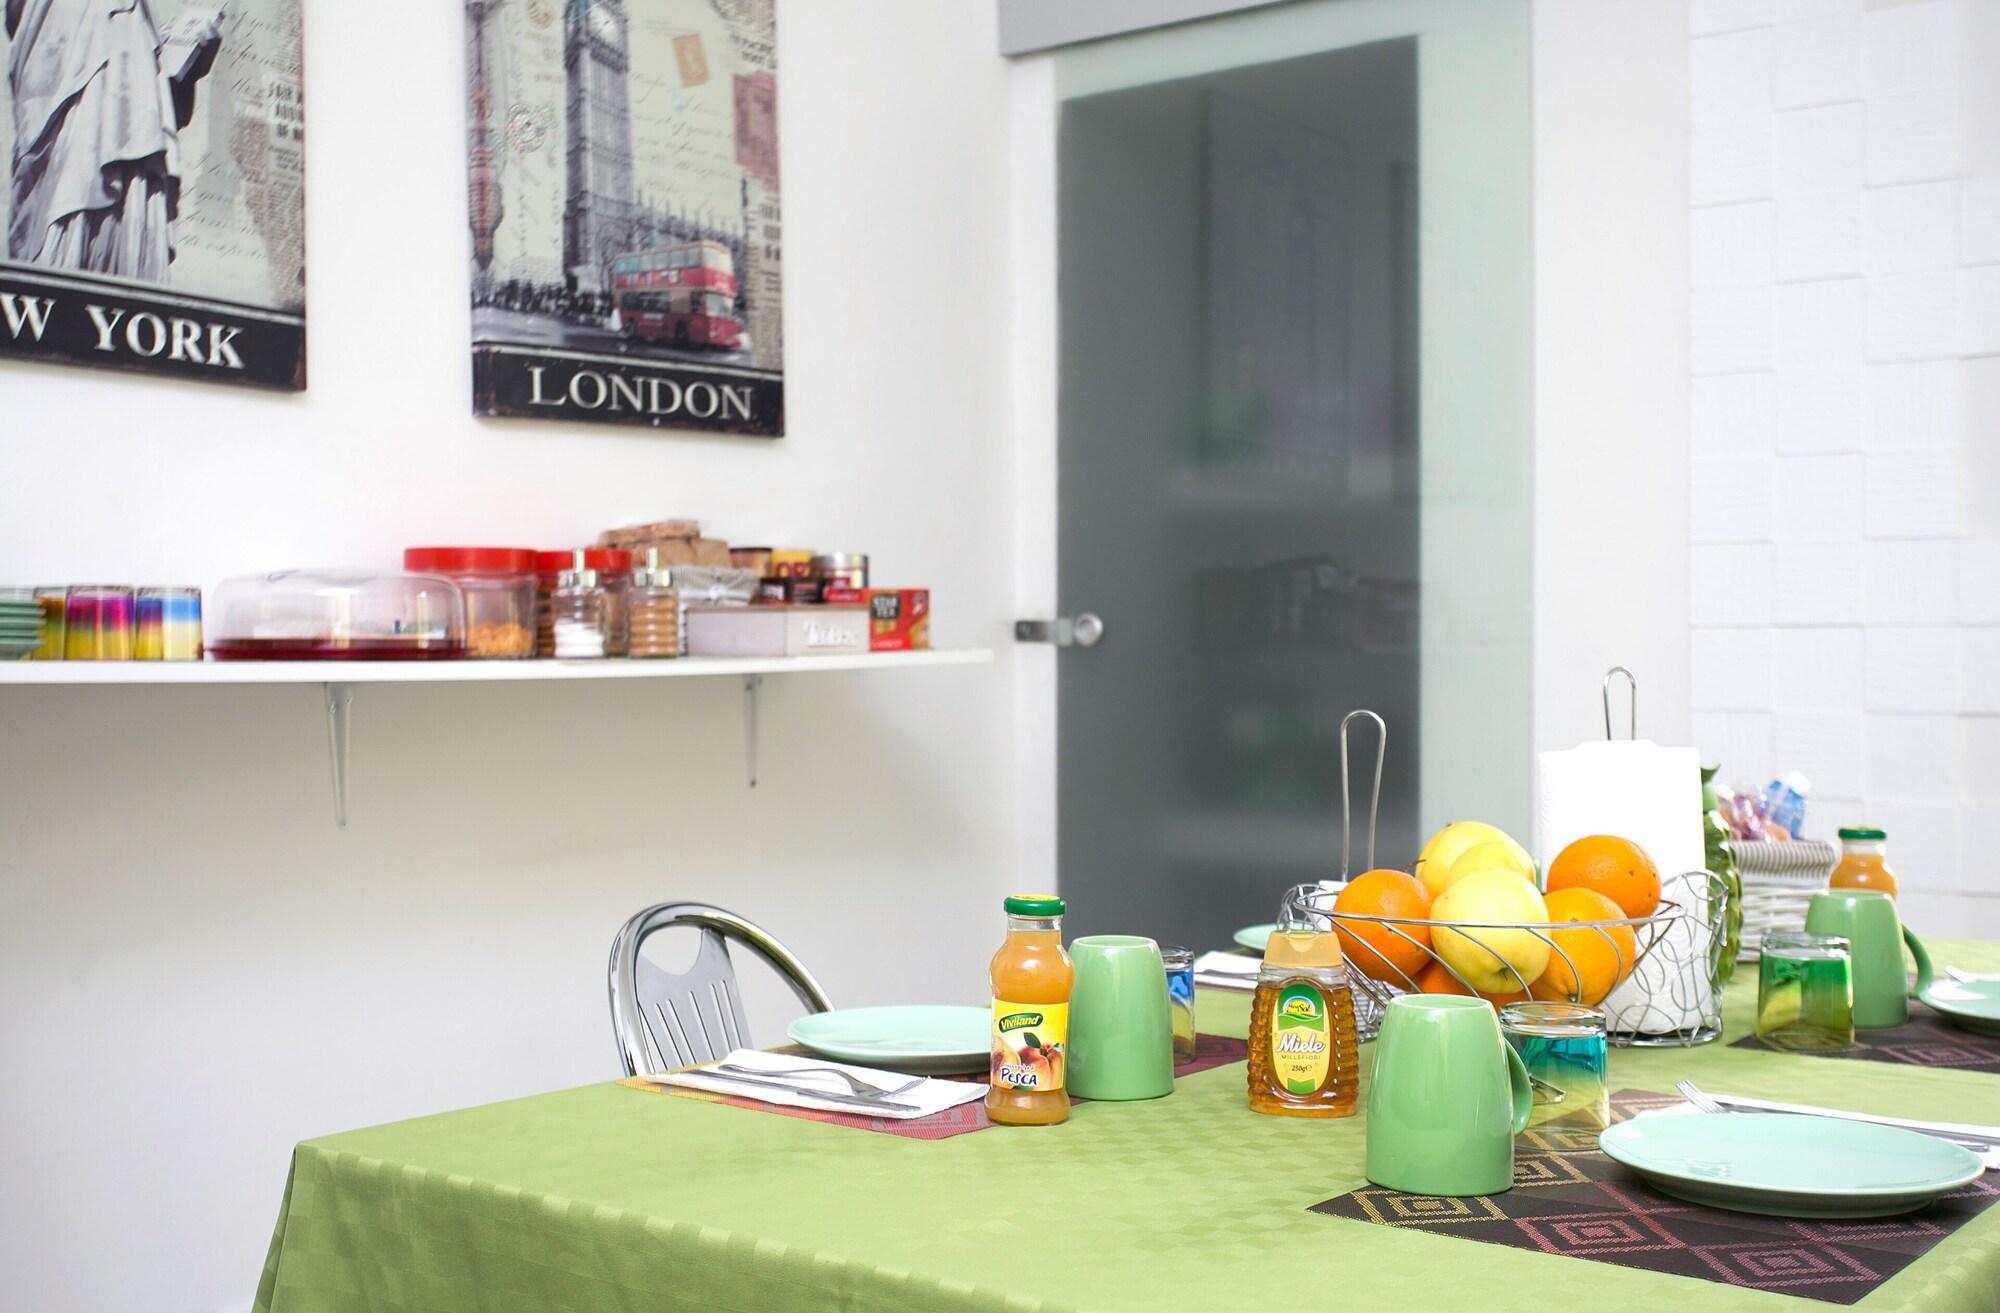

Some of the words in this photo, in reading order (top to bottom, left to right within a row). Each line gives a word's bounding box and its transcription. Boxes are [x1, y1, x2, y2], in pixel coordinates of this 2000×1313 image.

[85, 304, 246, 370] YORK
[528, 366, 754, 421] LONDON
[1000, 1015, 1040, 1030] Viviland
[1276, 1031, 1326, 1053] Miele
